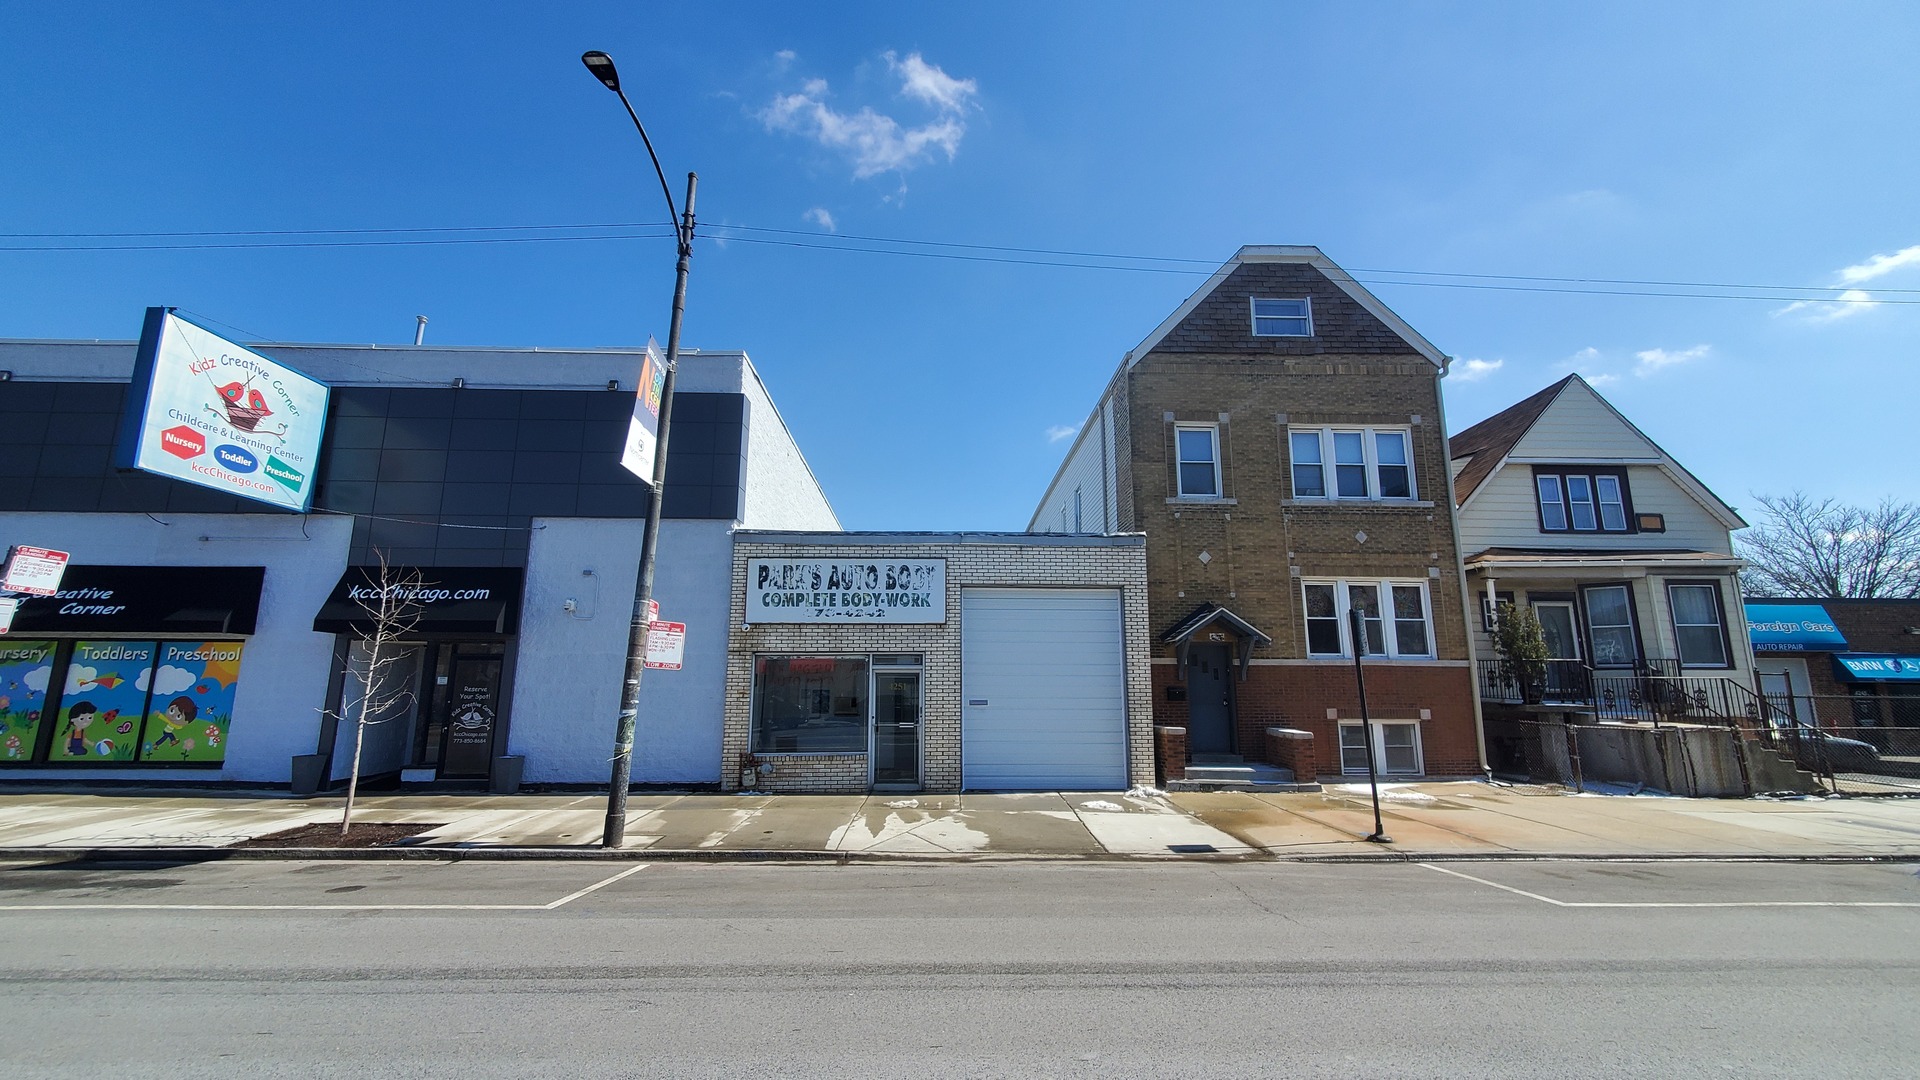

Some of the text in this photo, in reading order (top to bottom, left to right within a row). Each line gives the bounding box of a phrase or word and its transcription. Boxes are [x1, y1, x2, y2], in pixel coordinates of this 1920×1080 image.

[189, 354, 300, 417] Kidz Creative Corner
[165, 432, 202, 452] Nursery
[168, 408, 304, 463] Childcare & Learning Center
[220, 450, 253, 467] Toddler
[191, 461, 274, 493] kccChicago.com
[266, 464, 303, 483] Preschool
[827, 564, 879, 591] AUTO
[885, 564, 937, 591] BODY
[348, 584, 490, 603] kccChicago.com
[762, 592, 931, 608] COMPLETE BODY-WORK
[59, 602, 126, 615] Corner
[1747, 621, 1835, 634] Foreign Cars
[82, 646, 149, 661] Toddlers
[167, 646, 241, 661] Preschool
[1847, 661, 1884, 670] BMW
[482, 705, 495, 717] Corner
